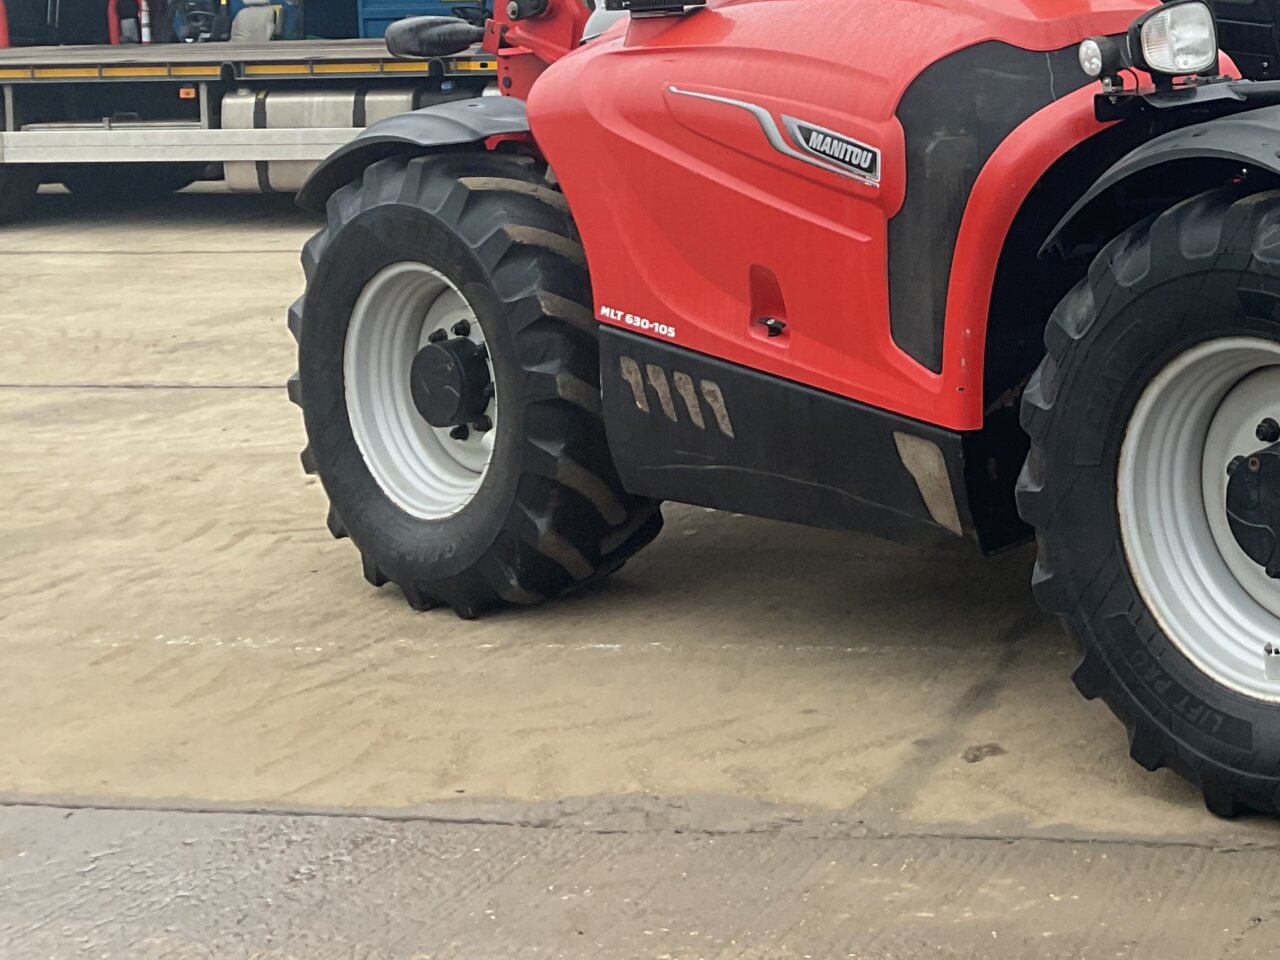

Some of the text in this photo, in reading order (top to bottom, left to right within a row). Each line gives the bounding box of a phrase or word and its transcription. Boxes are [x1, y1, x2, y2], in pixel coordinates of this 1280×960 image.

[808, 131, 873, 169] MANITOU
[600, 305, 676, 338] MLT 630-105
